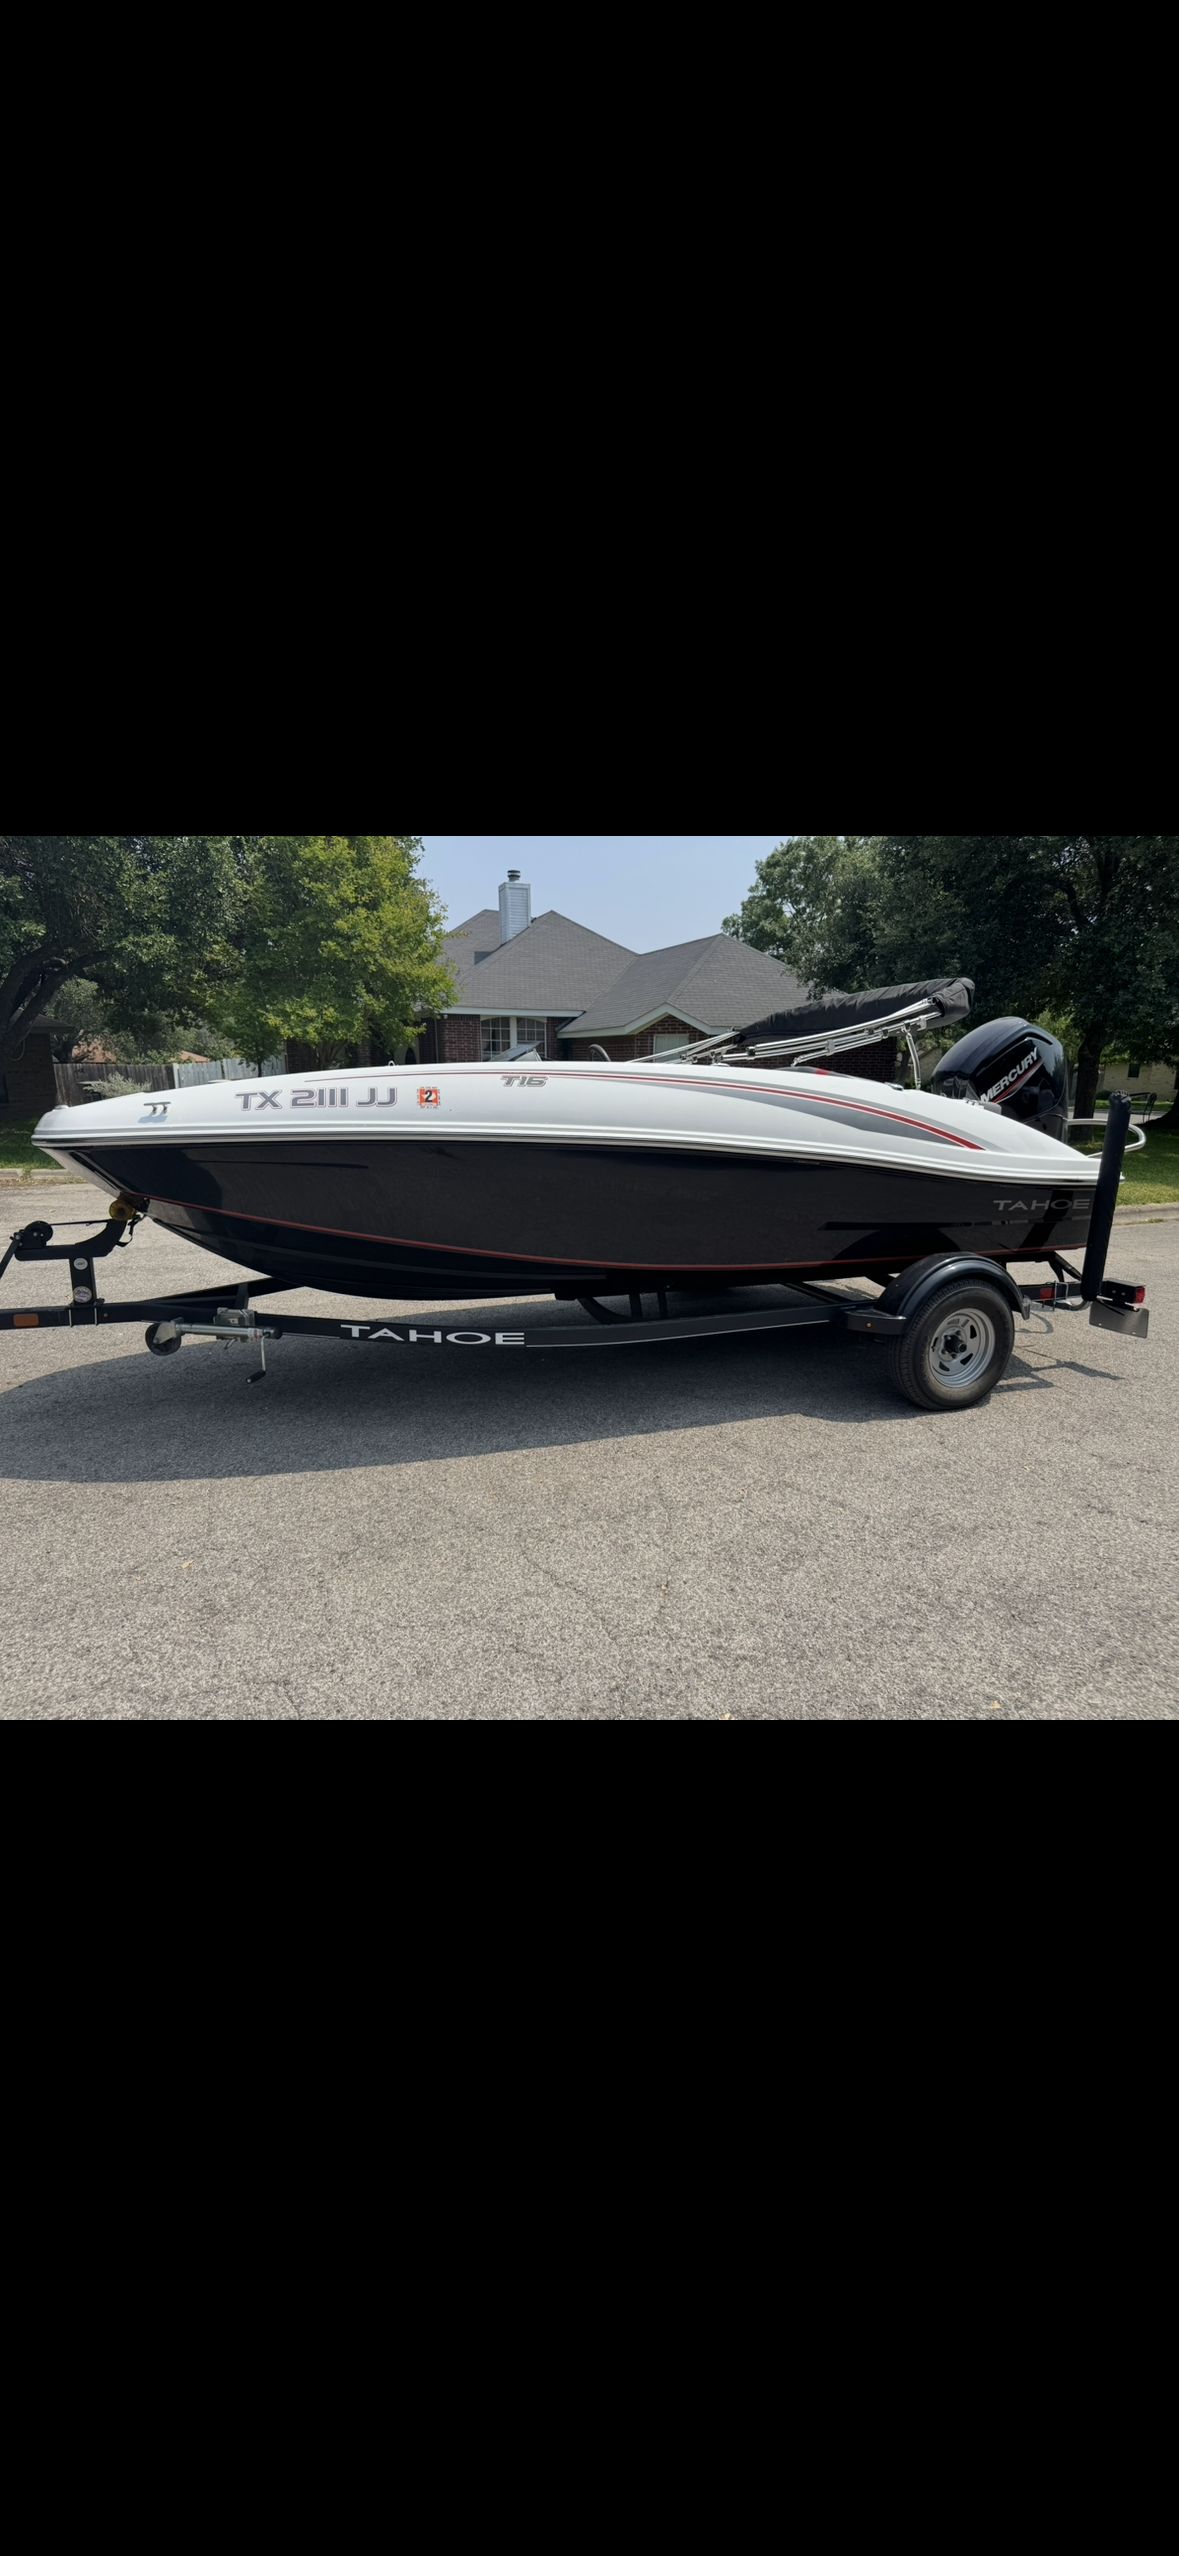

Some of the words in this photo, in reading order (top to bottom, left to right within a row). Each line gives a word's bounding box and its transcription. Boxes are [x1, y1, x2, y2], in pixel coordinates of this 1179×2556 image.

[501, 1075, 549, 1087] T16
[980, 1046, 1038, 1103] MERCURY
[234, 1089, 282, 1111] TX
[290, 1087, 349, 1109] 2111
[356, 1086, 398, 1108] JJ
[424, 1089, 433, 1103] 2
[993, 1198, 1091, 1212] TAHOE
[340, 1324, 525, 1345] TAHOE
